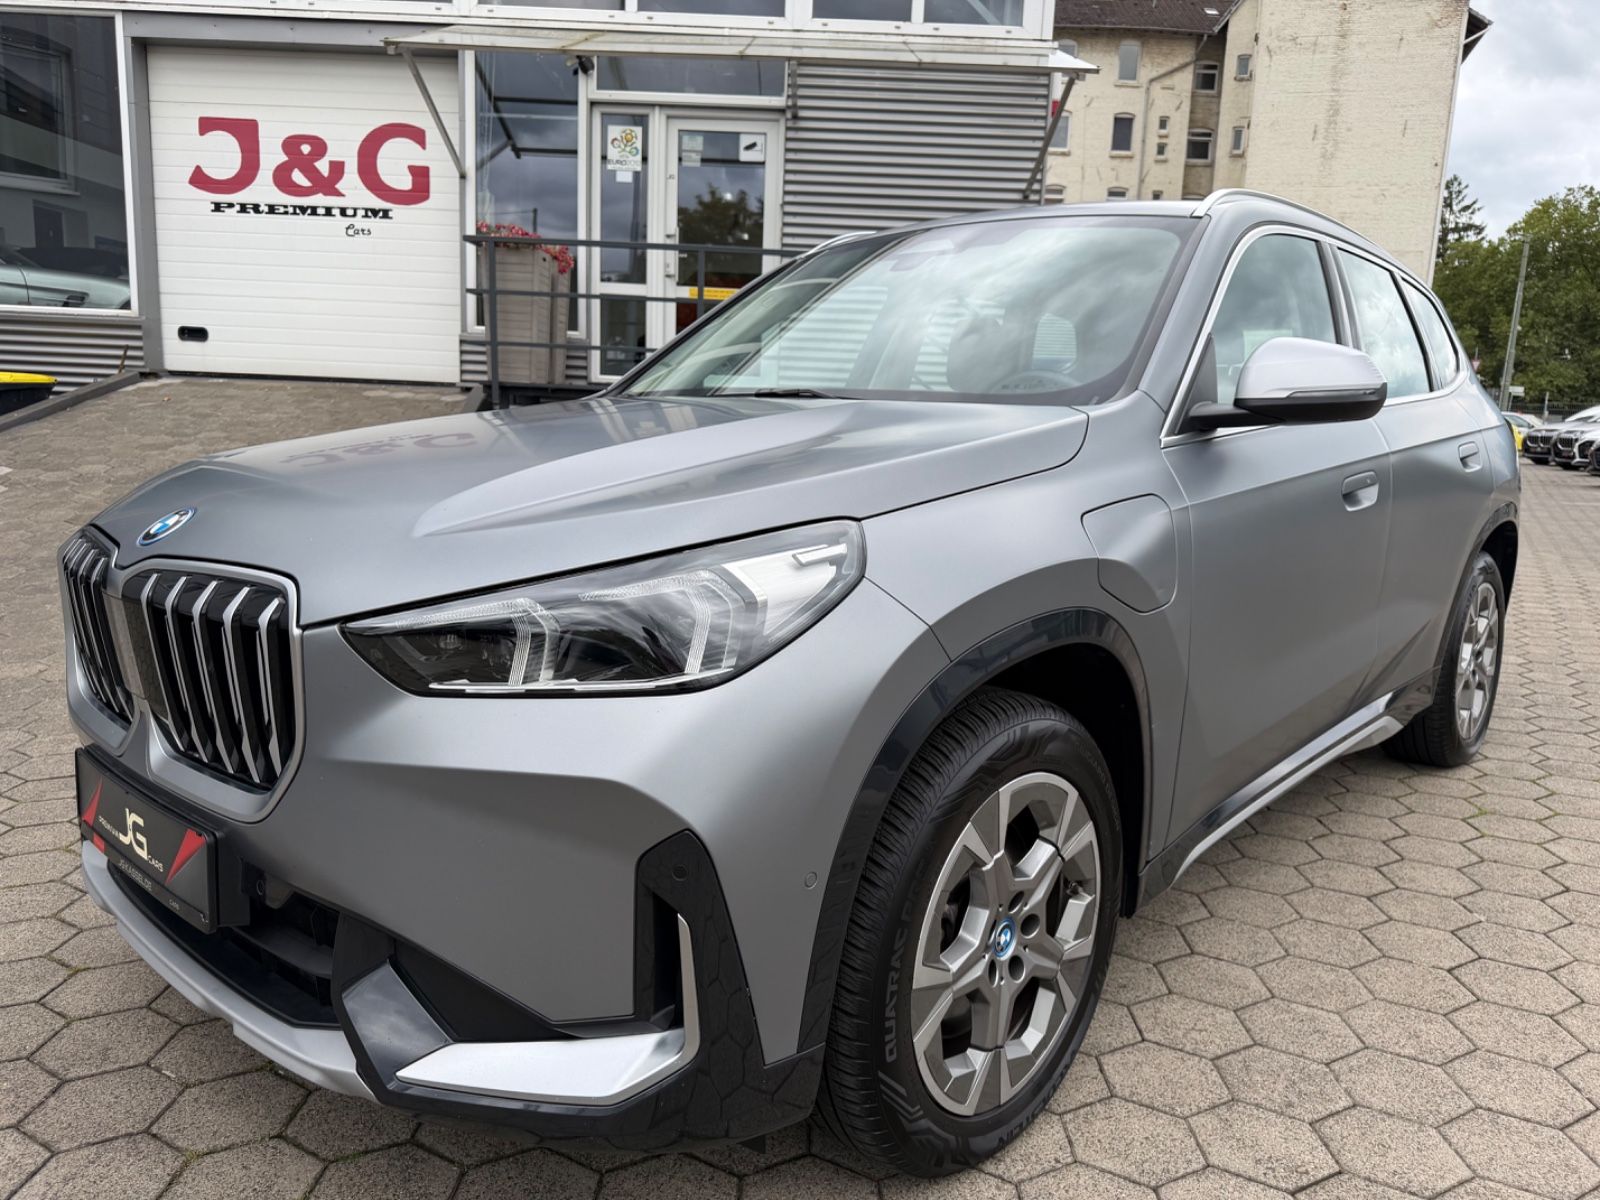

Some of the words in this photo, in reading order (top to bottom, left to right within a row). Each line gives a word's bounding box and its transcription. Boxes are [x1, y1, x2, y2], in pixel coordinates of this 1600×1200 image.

[188, 116, 430, 206] J&G
[210, 201, 393, 220] PREMIUM
[345, 224, 372, 237] Cars
[147, 854, 164, 872] CARS
[884, 927, 908, 1063] QUATRAC
